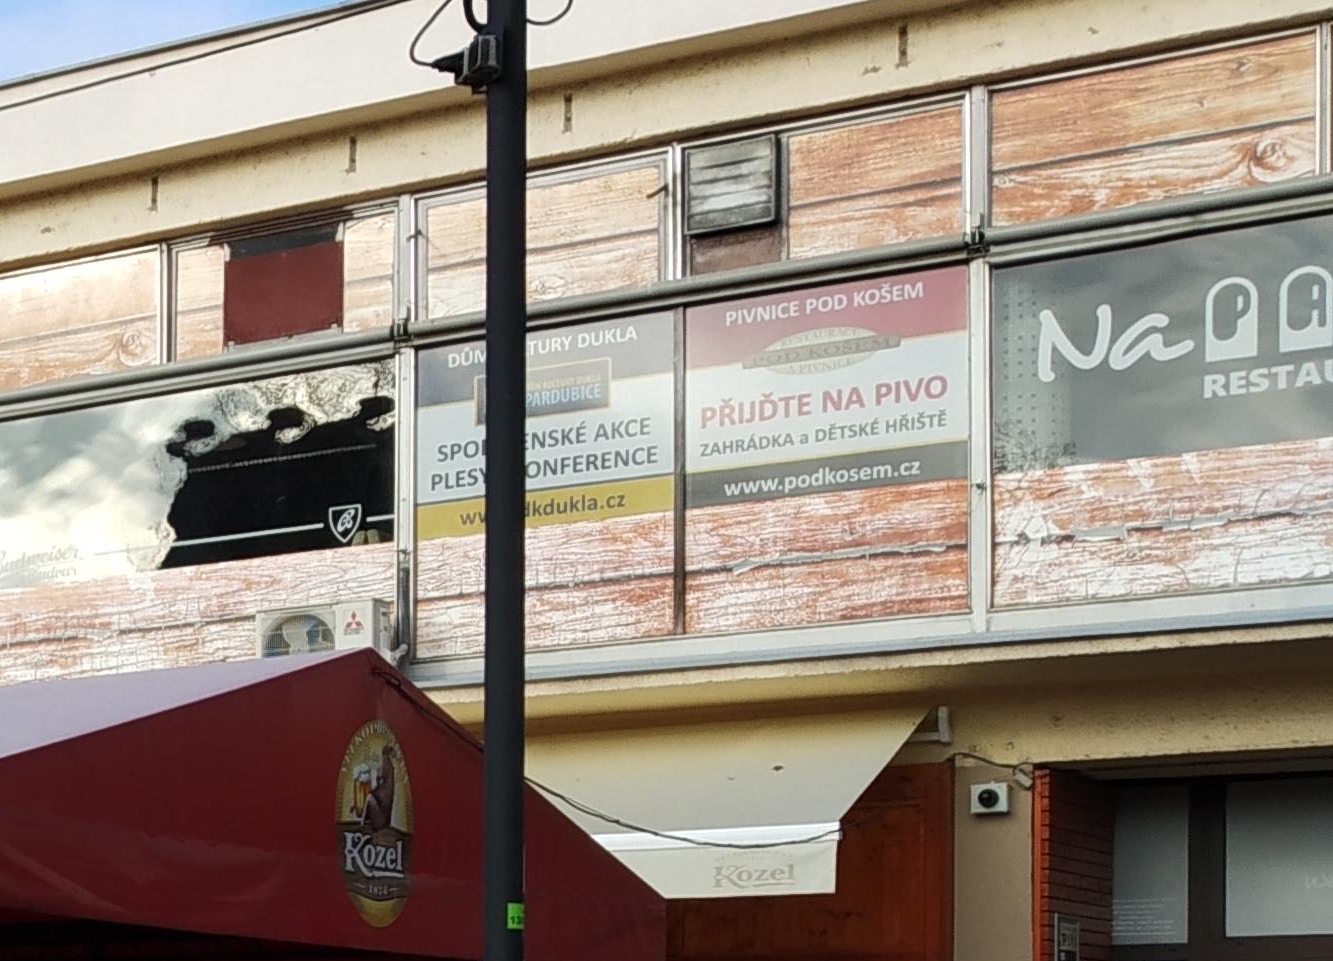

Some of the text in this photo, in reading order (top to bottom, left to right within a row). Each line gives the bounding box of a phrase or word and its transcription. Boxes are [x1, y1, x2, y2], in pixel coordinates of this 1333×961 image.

[726, 281, 924, 326] PIVNICE POD KOŠEM
[578, 326, 638, 348] DUKLA
[781, 328, 857, 347] RESTAURACE
[1037, 304, 1194, 382] Na
[752, 350, 800, 367] POD
[700, 374, 948, 429] PŘIJĎTE NA PIVO
[594, 417, 651, 442] AKCE
[699, 408, 948, 458] ZAHRÁDKA a DĚTSKÉ HŘIŠTĚ
[525, 445, 659, 479] ONFERENCE
[723, 458, 921, 498] www.podkosem.cz
[344, 832, 404, 877] Kozel
[713, 863, 796, 889] Kozel
